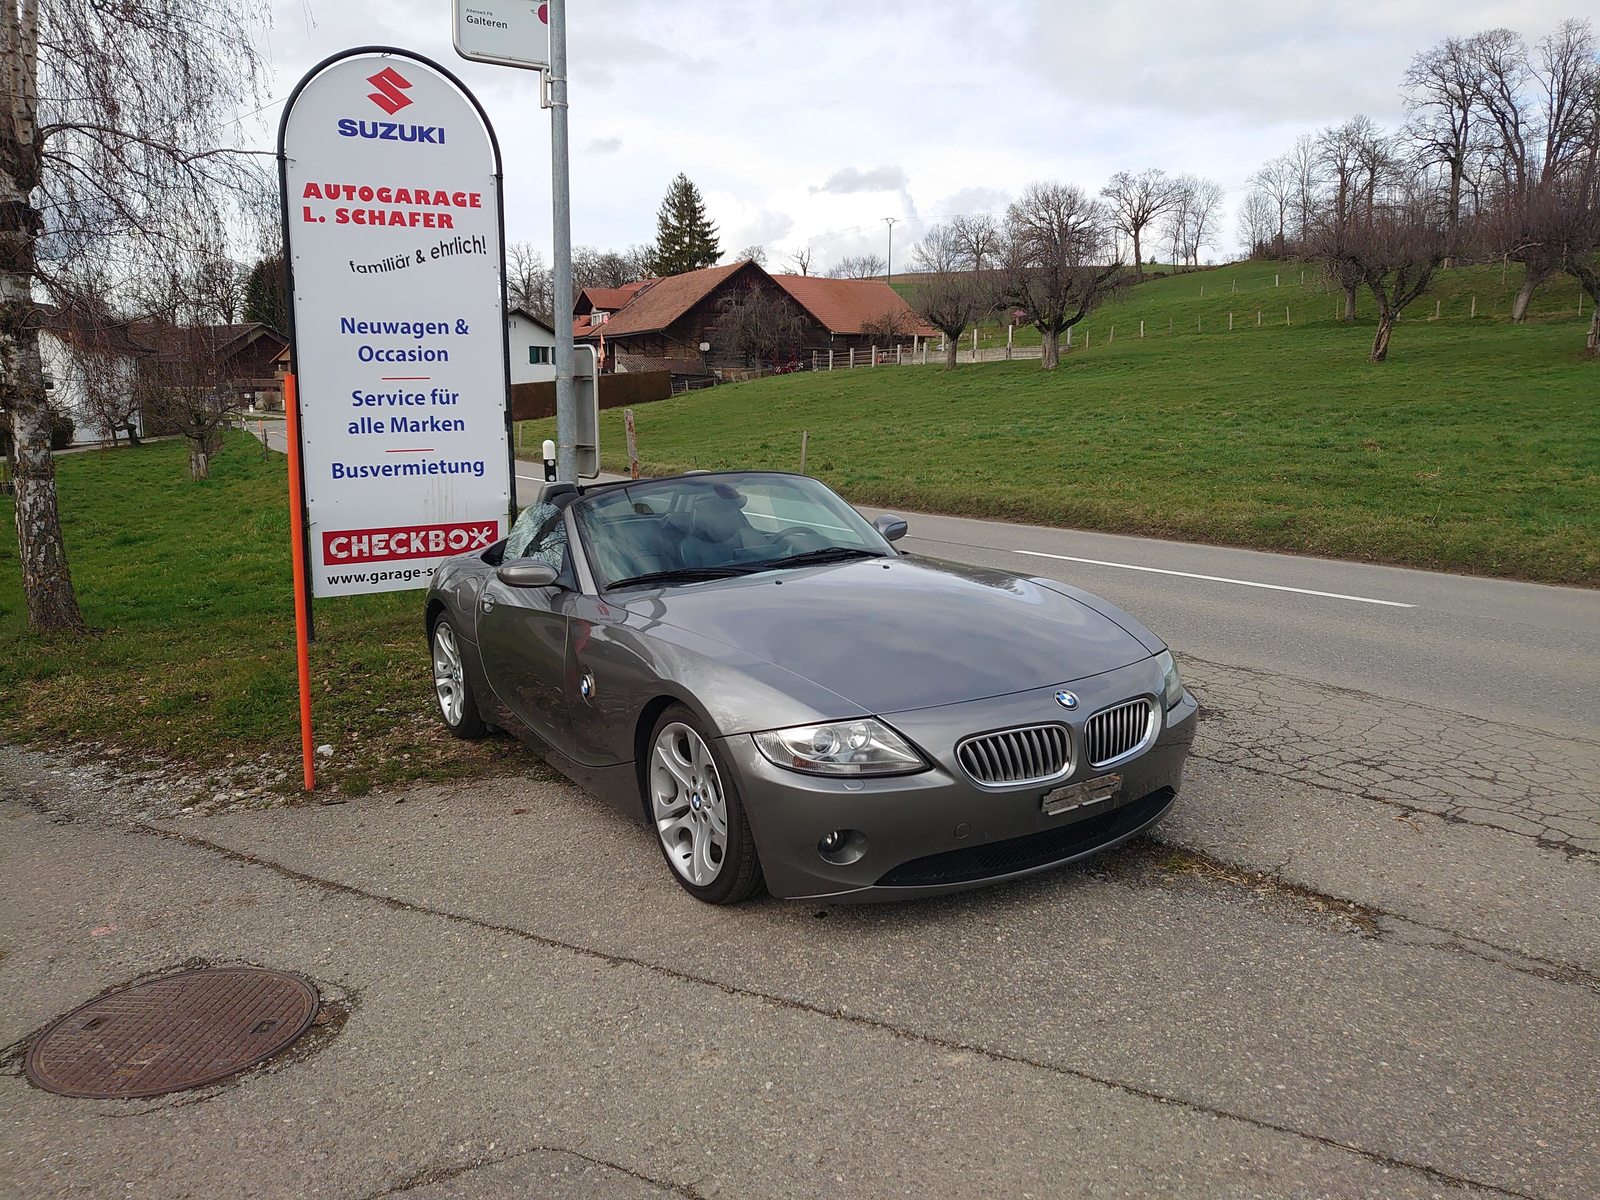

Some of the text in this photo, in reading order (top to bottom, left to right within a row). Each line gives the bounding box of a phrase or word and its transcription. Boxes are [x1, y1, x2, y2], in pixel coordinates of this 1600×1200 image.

[466, 15, 508, 29] Galteren
[338, 118, 445, 144] SUZUKI
[303, 182, 481, 208] AUTOGARAGE
[303, 206, 454, 229] L. SCHAFER
[349, 235, 487, 274] familiär & ehrlich!
[341, 317, 469, 339] Neuwagen &
[358, 345, 449, 363] Occasion
[352, 389, 459, 407] Service für
[348, 416, 465, 434] alle Marken
[332, 459, 485, 479] Busvermietung
[329, 526, 493, 559] CHECKBOX
